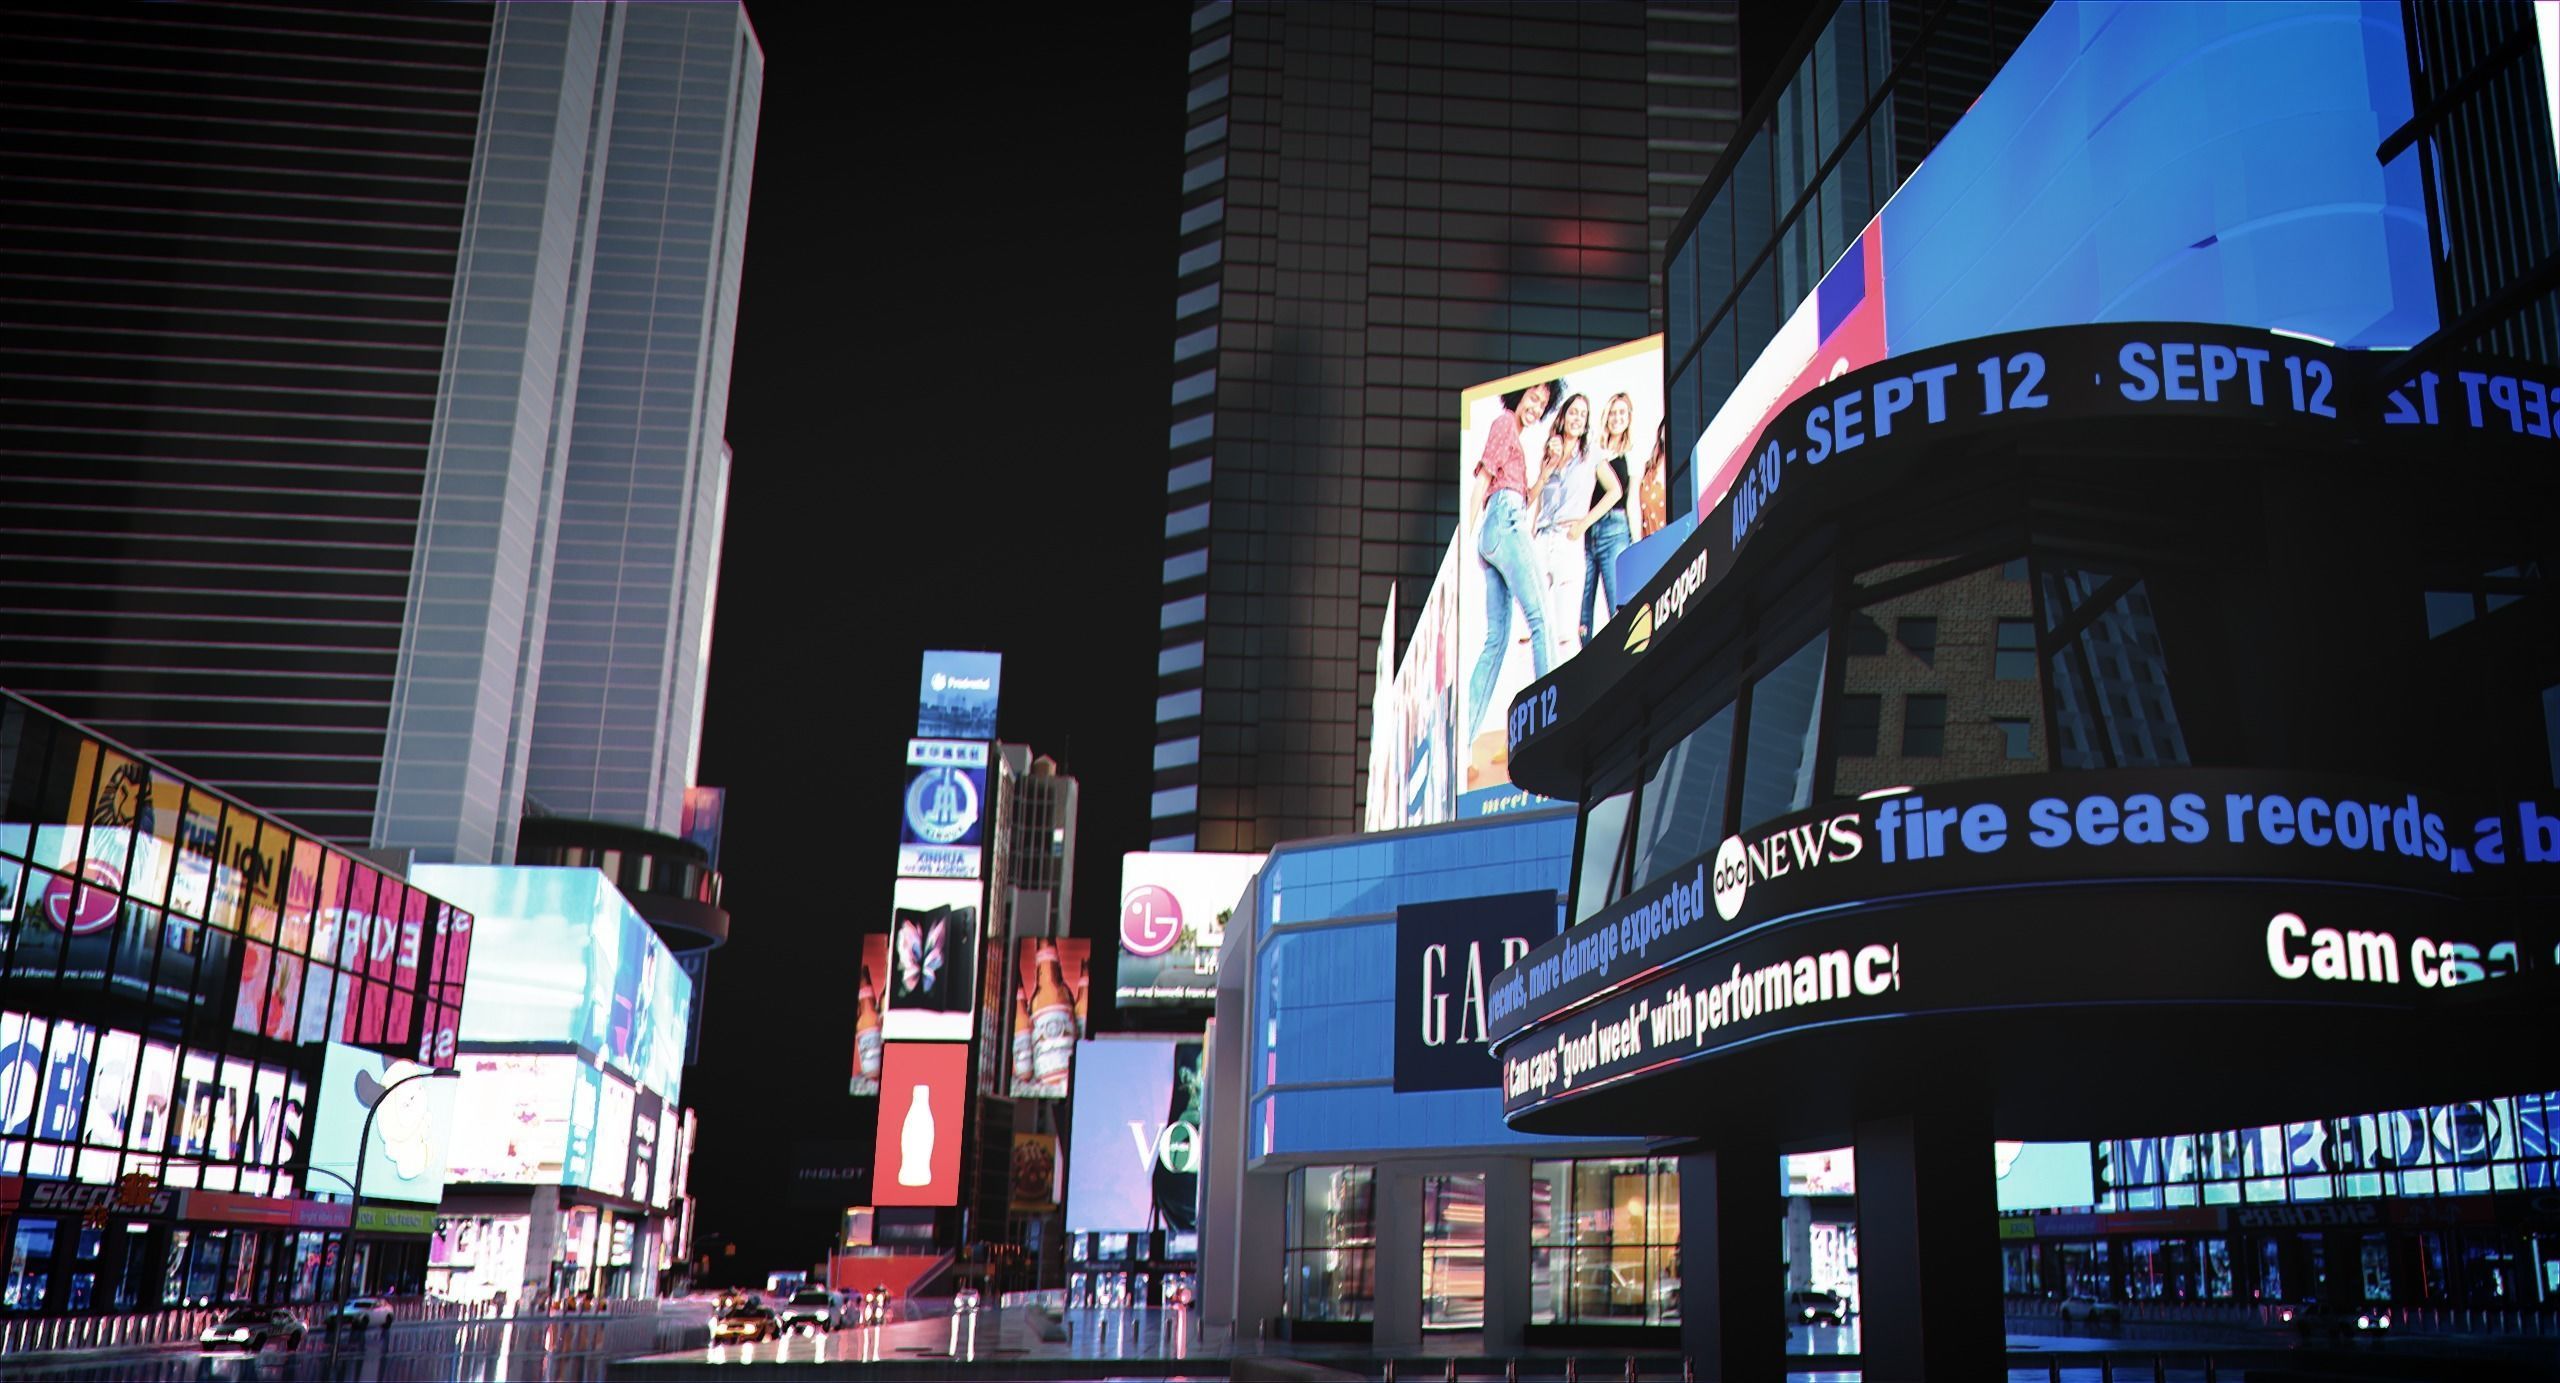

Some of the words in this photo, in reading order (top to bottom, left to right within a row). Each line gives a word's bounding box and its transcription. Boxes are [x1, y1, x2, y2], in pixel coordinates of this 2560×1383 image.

[2119, 341, 2270, 406] SEPT
[2284, 355, 2336, 418] 12
[1732, 468, 1757, 551] AUG
[1758, 439, 1780, 507] 30
[1806, 363, 1957, 465] SEPT
[1978, 352, 2048, 416] 12
[1541, 685, 1557, 728] 12
[1530, 956, 1559, 1000] more
[1562, 923, 1618, 984] damage
[1621, 863, 1704, 959] expected
[1746, 813, 1864, 887] NEWS
[1875, 796, 2007, 863] fire
[2028, 793, 2210, 848] seas
[2266, 912, 2399, 984] Cam
[1530, 1047, 1557, 1096] caps
[1650, 984, 1692, 1048] with
